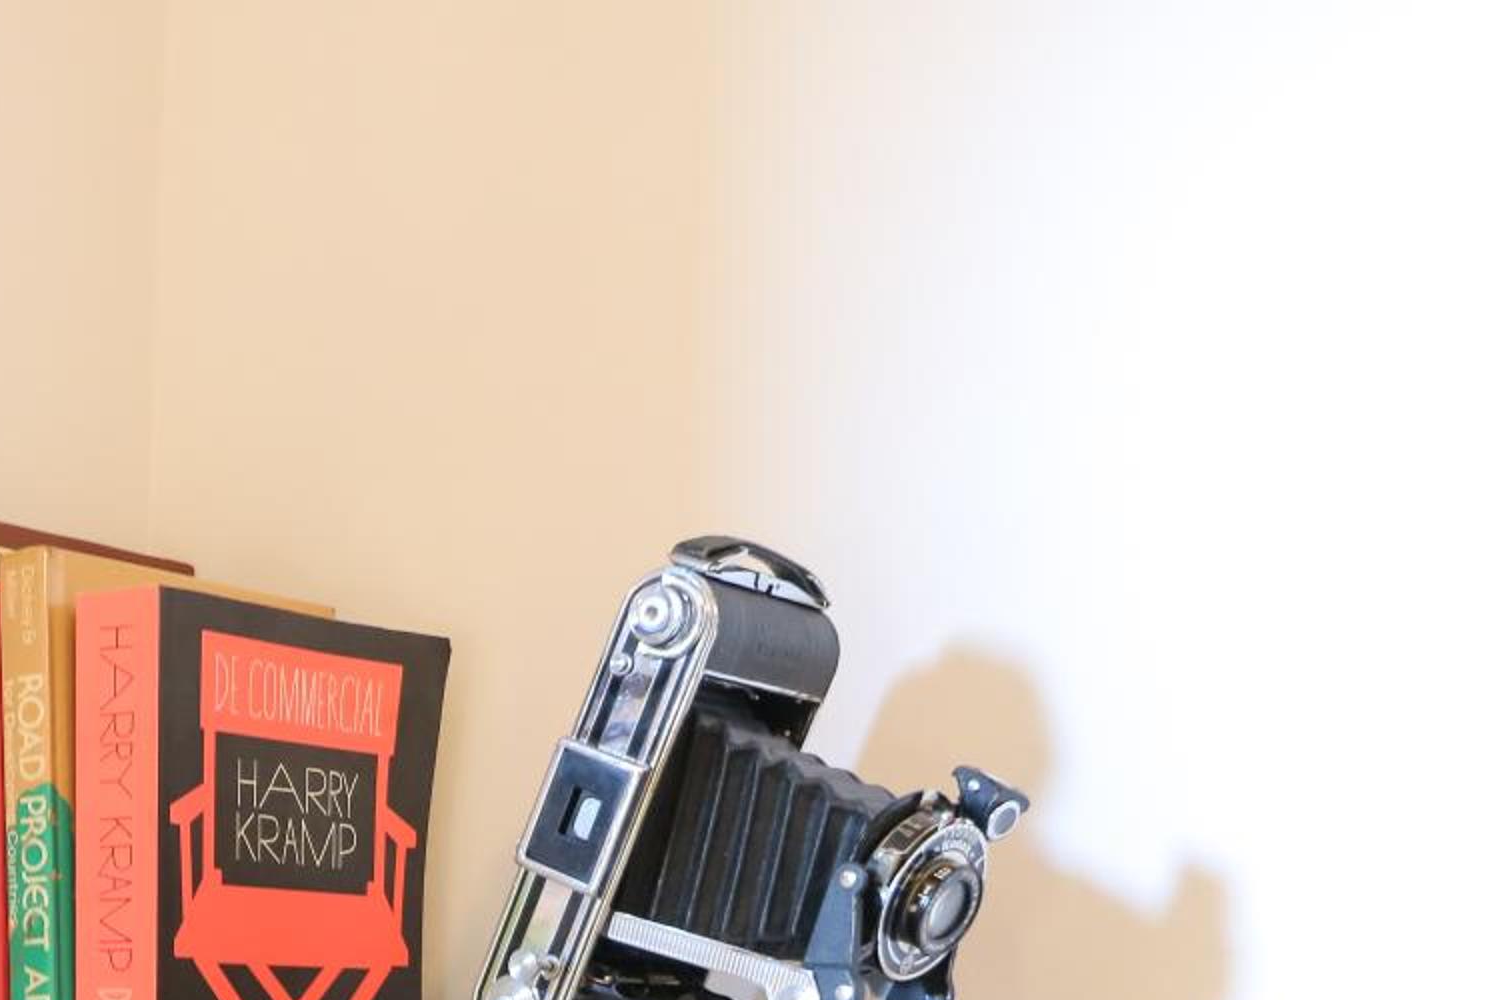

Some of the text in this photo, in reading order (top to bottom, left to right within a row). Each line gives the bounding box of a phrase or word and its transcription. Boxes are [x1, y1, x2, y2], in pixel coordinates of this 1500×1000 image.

[17, 672, 46, 781] ROAD
[99, 624, 135, 800] HARRY
[214, 651, 384, 738] DE COMMERCIAL
[235, 812, 358, 871] KRAMP
[237, 756, 360, 820] HARRY
[20, 794, 51, 952] PROJECT
[99, 816, 133, 973] KRAMP
